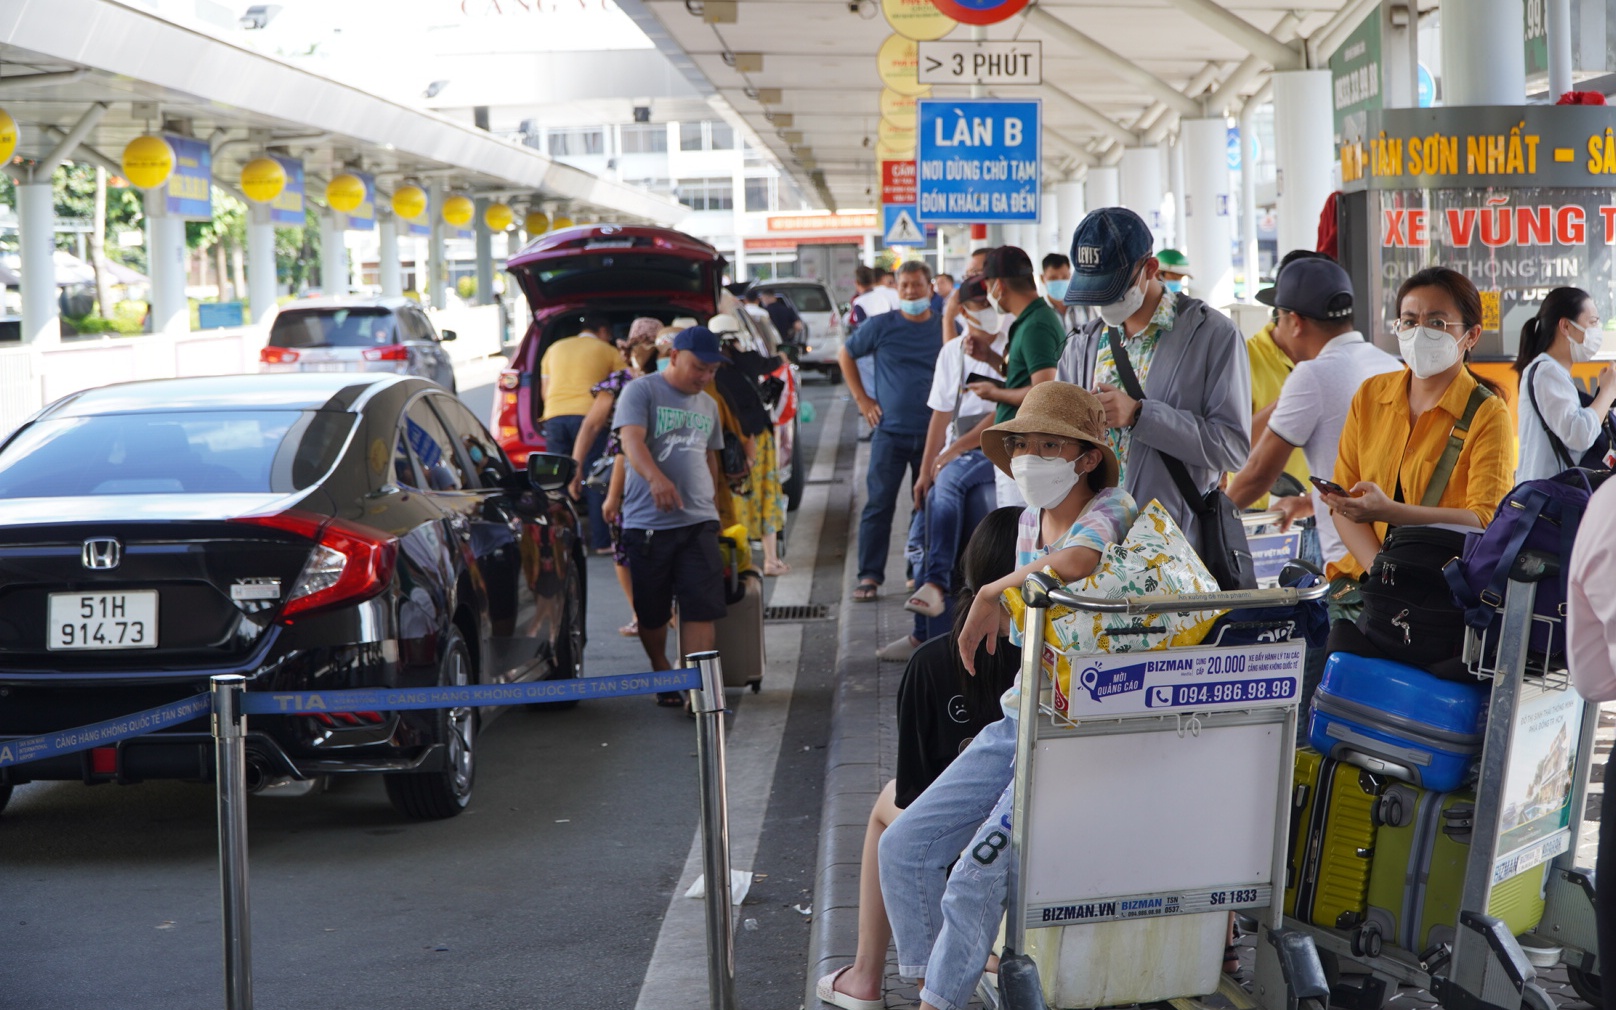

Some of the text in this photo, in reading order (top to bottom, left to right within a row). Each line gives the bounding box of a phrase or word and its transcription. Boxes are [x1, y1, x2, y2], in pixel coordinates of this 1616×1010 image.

[952, 53, 964, 77] 3
[974, 48, 1032, 77] PHÚT
[935, 107, 1023, 147] LÀN B
[1370, 130, 1403, 177] TÂN
[1408, 132, 1459, 176] SƠN
[1467, 121, 1540, 174] NHẤT
[921, 155, 1036, 183] NƠI DỪNG CHỜ TẠM
[921, 185, 1036, 213] ĐÓN KHÁCH GA ĐẾN
[1384, 208, 1429, 247] XE
[1446, 196, 1586, 248] VŨNG
[80, 596, 126, 619] 51H
[62, 622, 144, 645] 914.73
[1113, 671, 1127, 683] MỜI
[1147, 658, 1193, 673] BIZMAN
[1207, 654, 1245, 675] 20.000
[1097, 679, 1139, 696] QUẢNG CÁO
[1179, 680, 1290, 704] 094.986.98.98
[273, 694, 326, 710] TIA
[972, 831, 1008, 865] 8
[1042, 889, 1257, 922] BIZMAN.VN BIZMAN TSN SG 1833
[1164, 906, 1180, 914] 0537
